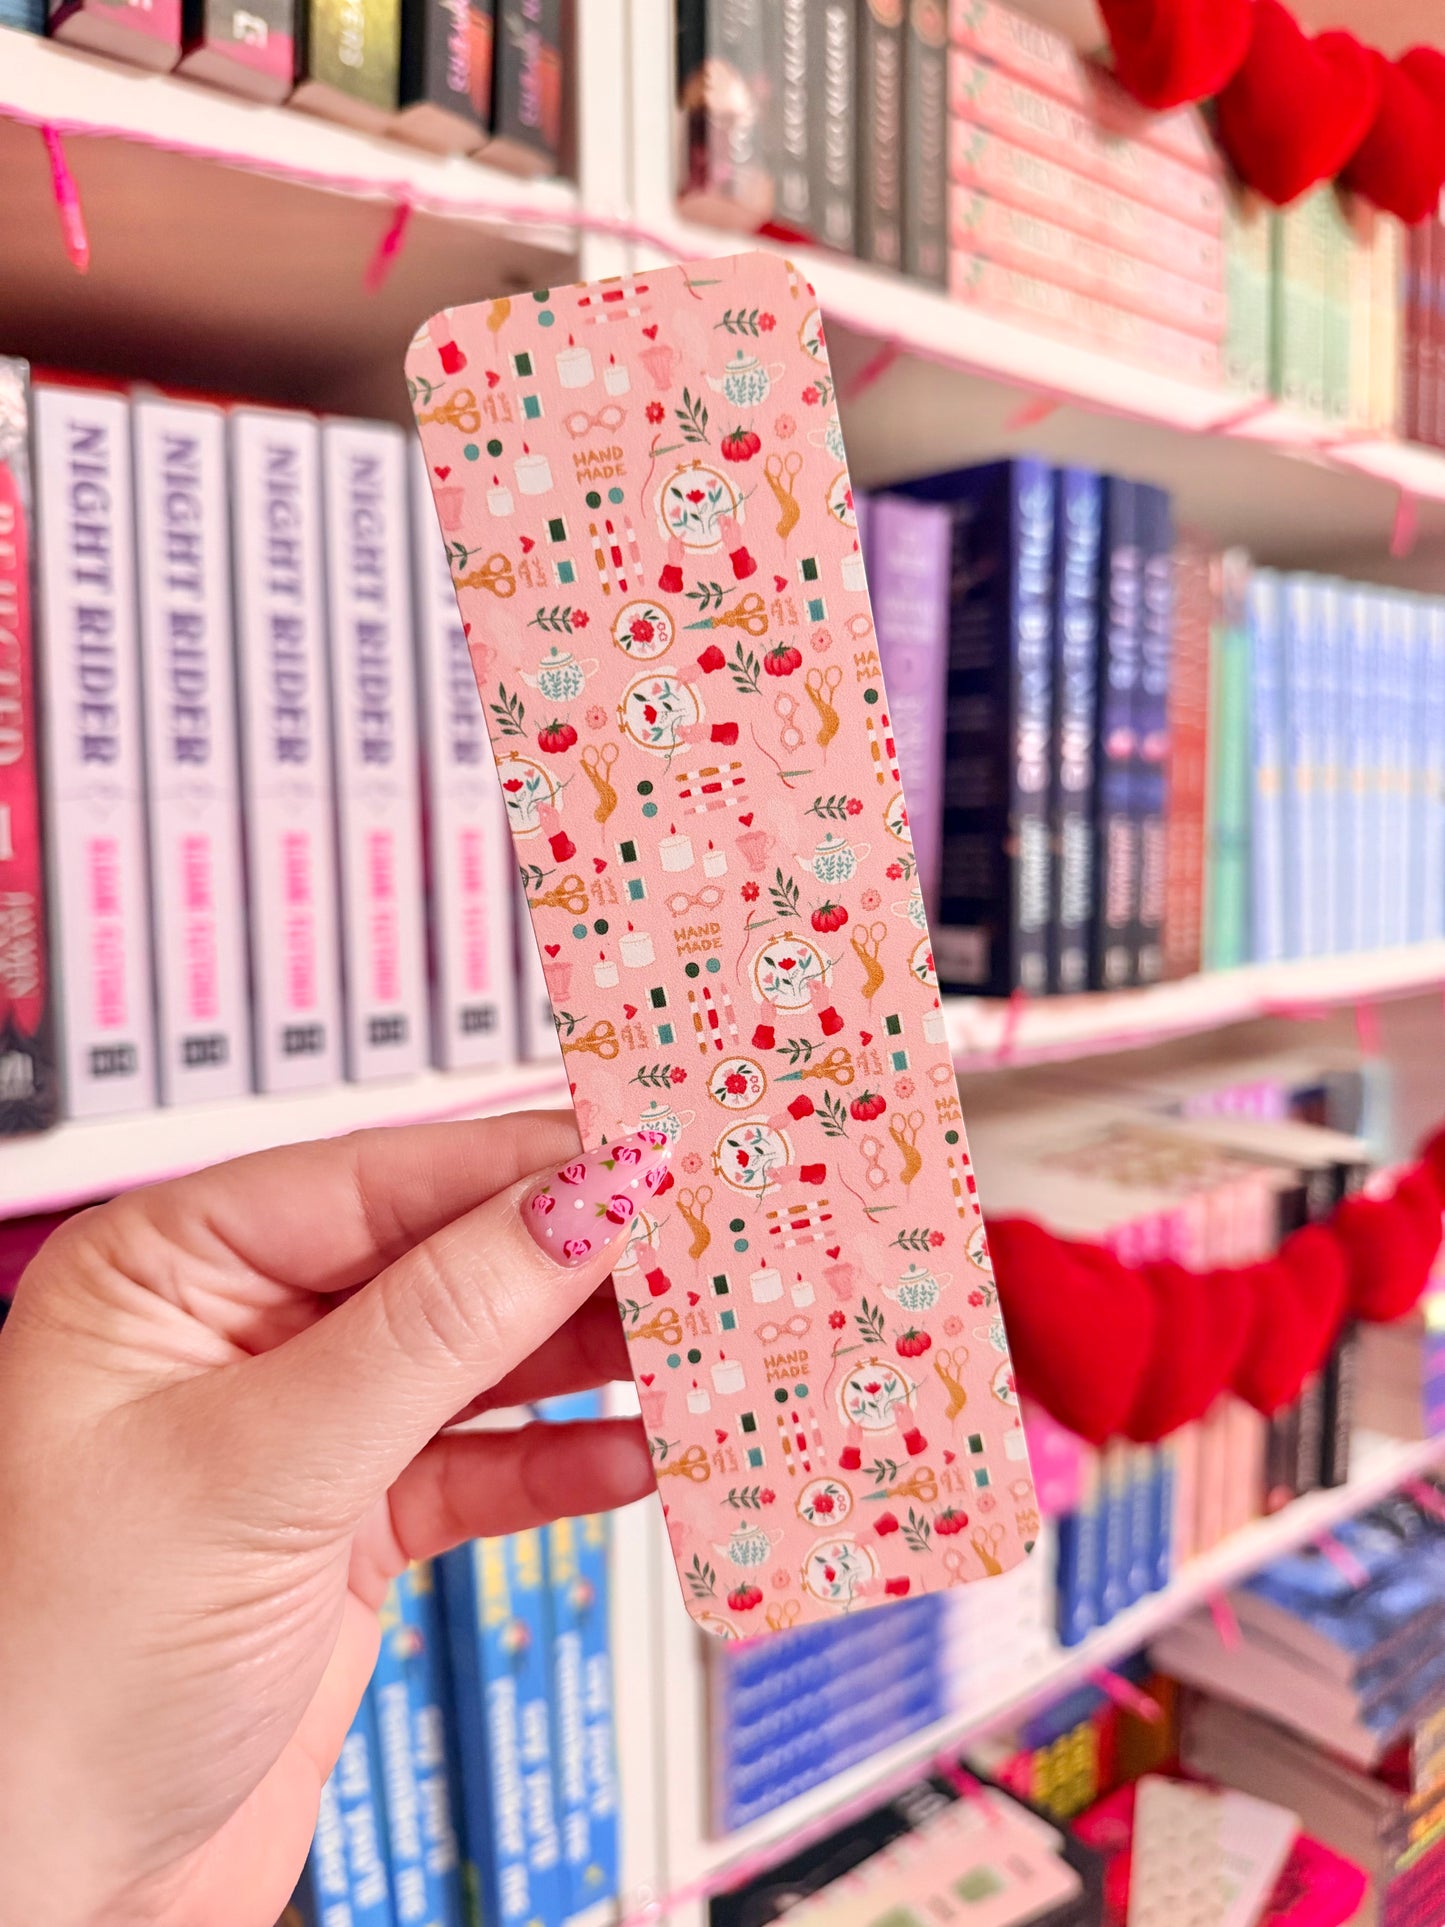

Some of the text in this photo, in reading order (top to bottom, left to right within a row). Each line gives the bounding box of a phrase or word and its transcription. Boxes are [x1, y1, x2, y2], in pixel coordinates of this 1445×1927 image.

[572, 446, 624, 468] HAND
[576, 463, 628, 485] MADE
[68, 415, 117, 766] NIGHT RIDER
[162, 432, 210, 766] NIGHT RIDER
[264, 442, 309, 766] NIGHT RIDER
[853, 650, 879, 667] HA
[856, 666, 882, 682] MA
[673, 922, 721, 942] HAND
[676, 937, 723, 957] MADE
[935, 1095, 959, 1110] HA
[938, 1110, 962, 1124] MA
[763, 1350, 809, 1369] HAND
[766, 1364, 810, 1383] MADE
[1014, 1508, 1039, 1522] HA
[1017, 1521, 1040, 1536] MA
